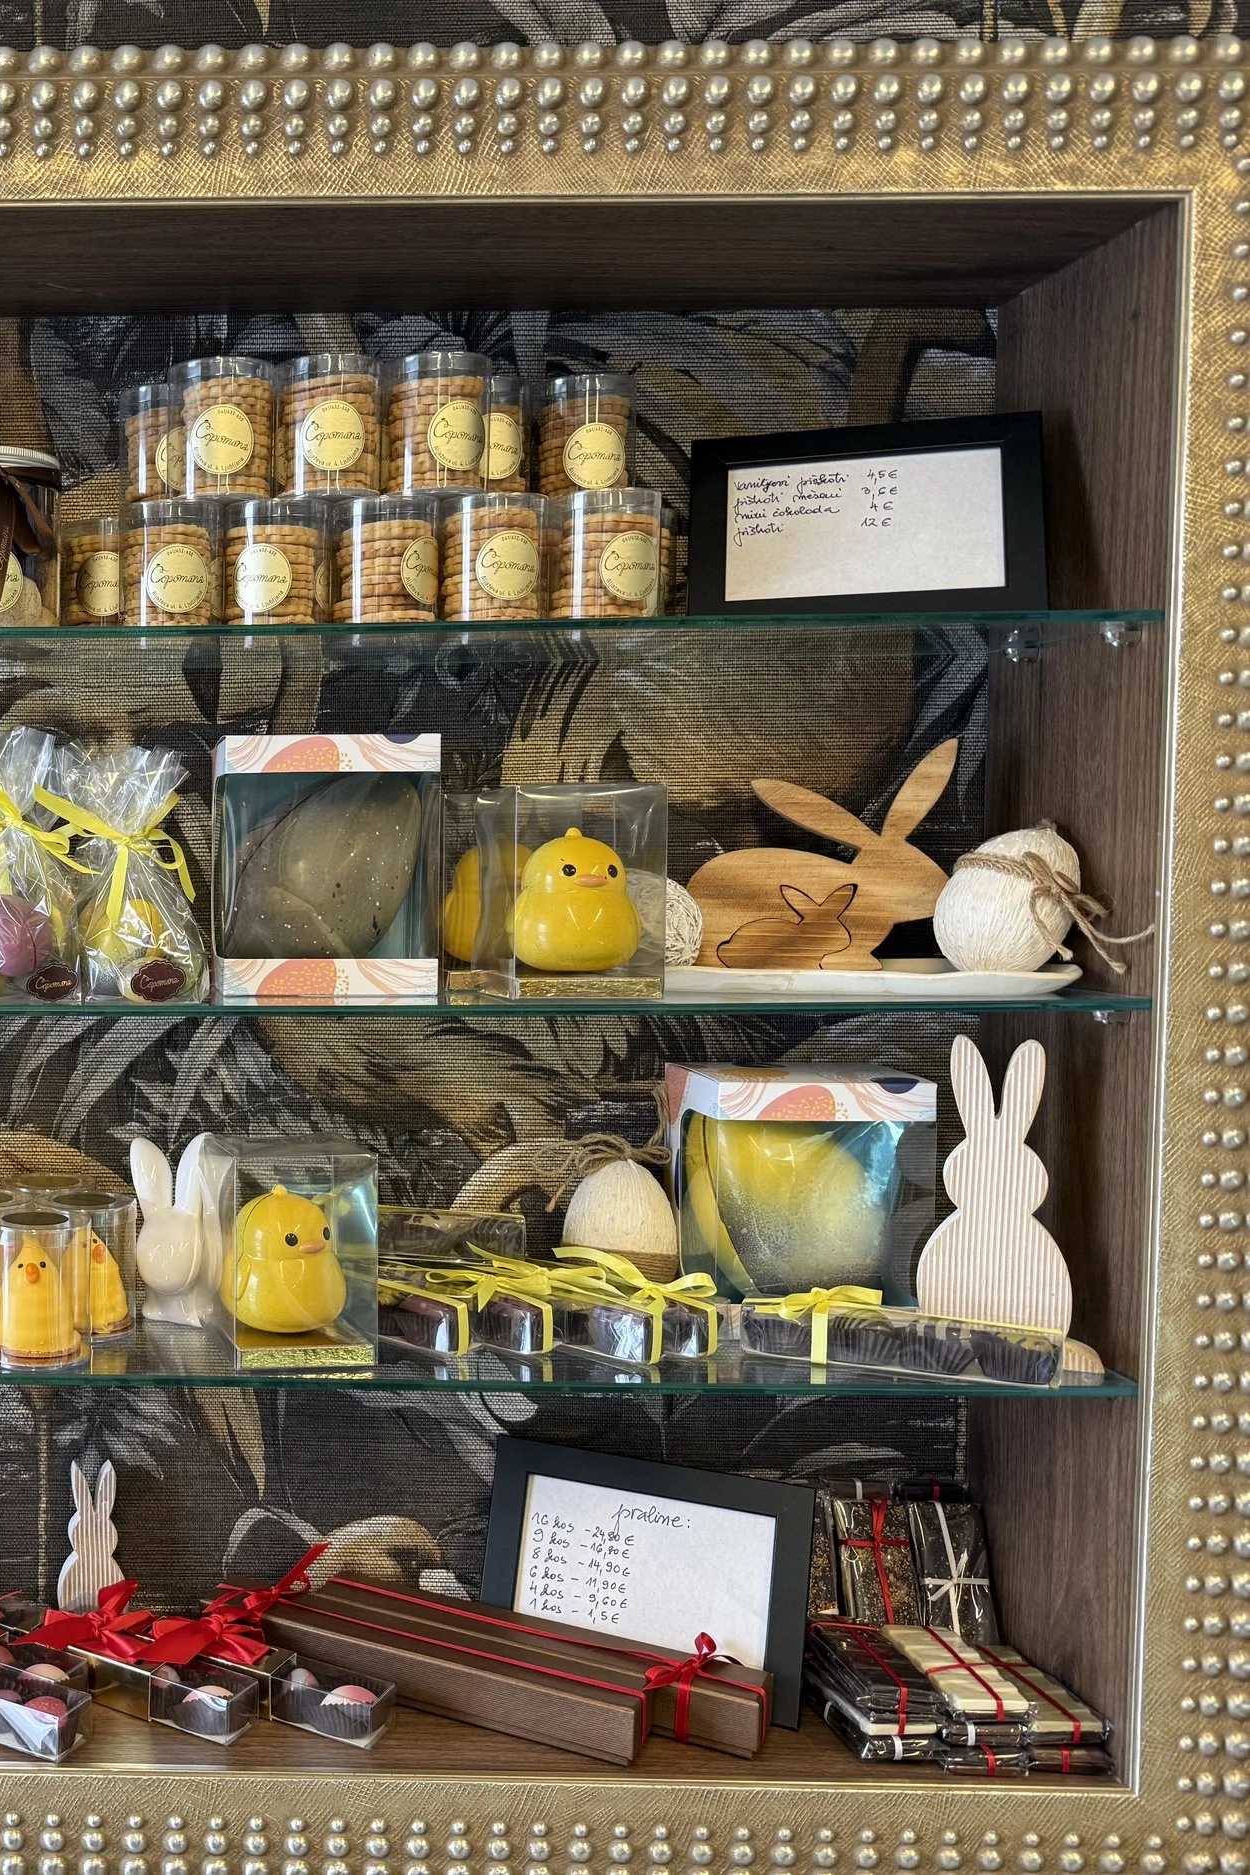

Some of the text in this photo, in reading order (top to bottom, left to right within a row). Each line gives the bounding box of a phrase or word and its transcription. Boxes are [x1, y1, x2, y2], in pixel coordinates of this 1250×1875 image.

[533, 1528, 544, 1542] 9
[532, 1547, 541, 1559] 8
[529, 1566, 538, 1578] 6
